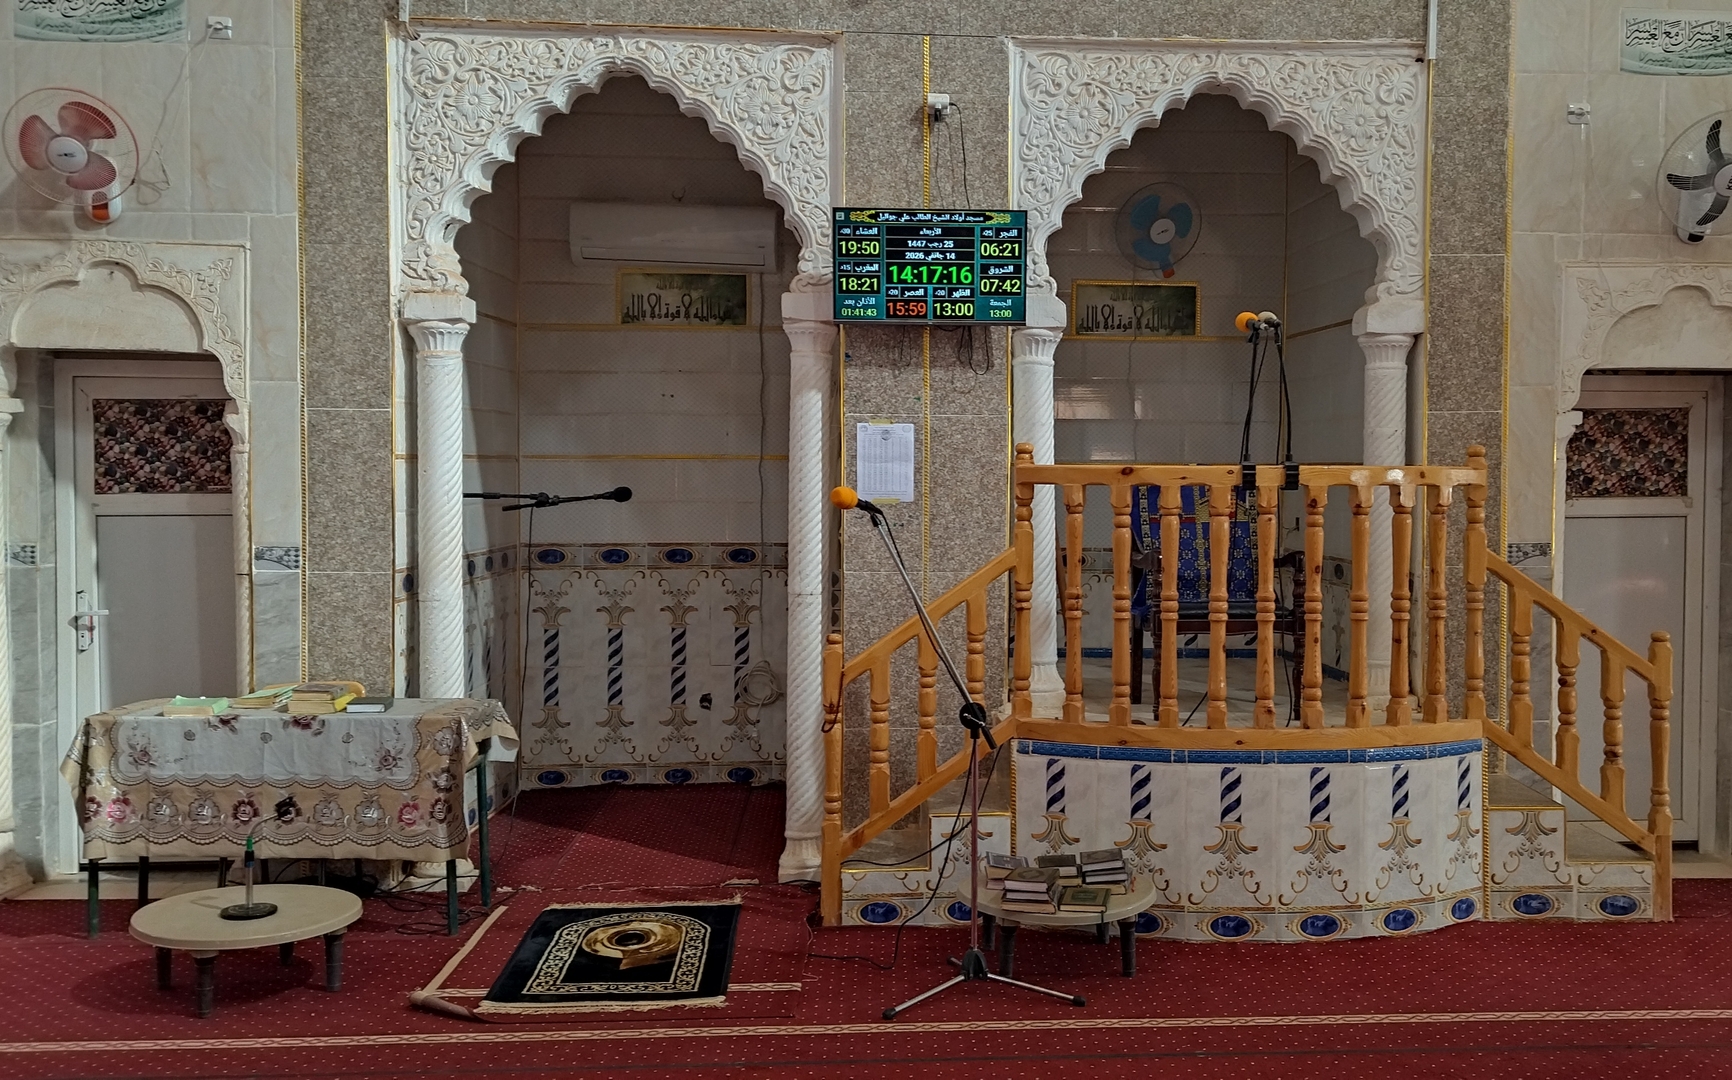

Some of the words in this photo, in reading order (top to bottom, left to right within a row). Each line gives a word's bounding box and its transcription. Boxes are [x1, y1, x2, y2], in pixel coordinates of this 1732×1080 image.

[911, 213, 931, 222] الطالب
[932, 213, 950, 223] الشيخ
[951, 212, 965, 222] أولاد
[966, 214, 984, 222] مسجد
[855, 227, 878, 235] العشاء
[919, 227, 942, 236] الأربعاء
[998, 229, 1018, 238] الفجر
[839, 241, 880, 255] 19:50
[927, 241, 943, 249] رجب
[943, 240, 954, 248] 25
[980, 243, 1019, 256] 06:21
[925, 252, 944, 261] جانفي
[945, 252, 956, 260] 14
[854, 263, 879, 272] المغرب
[988, 265, 1014, 275] الشروق
[889, 265, 972, 284] 14:17:16
[839, 277, 878, 291] 18:21
[980, 279, 1020, 292] 07:42
[903, 288, 924, 297] العصر
[951, 289, 971, 298] الظهر
[843, 298, 856, 306] بعد
[989, 299, 1012, 308] الجمعة
[841, 308, 877, 316] 01:41:43
[887, 302, 927, 316] 15:59
[933, 302, 974, 316] 13:00
[989, 309, 1012, 318] 13:00
